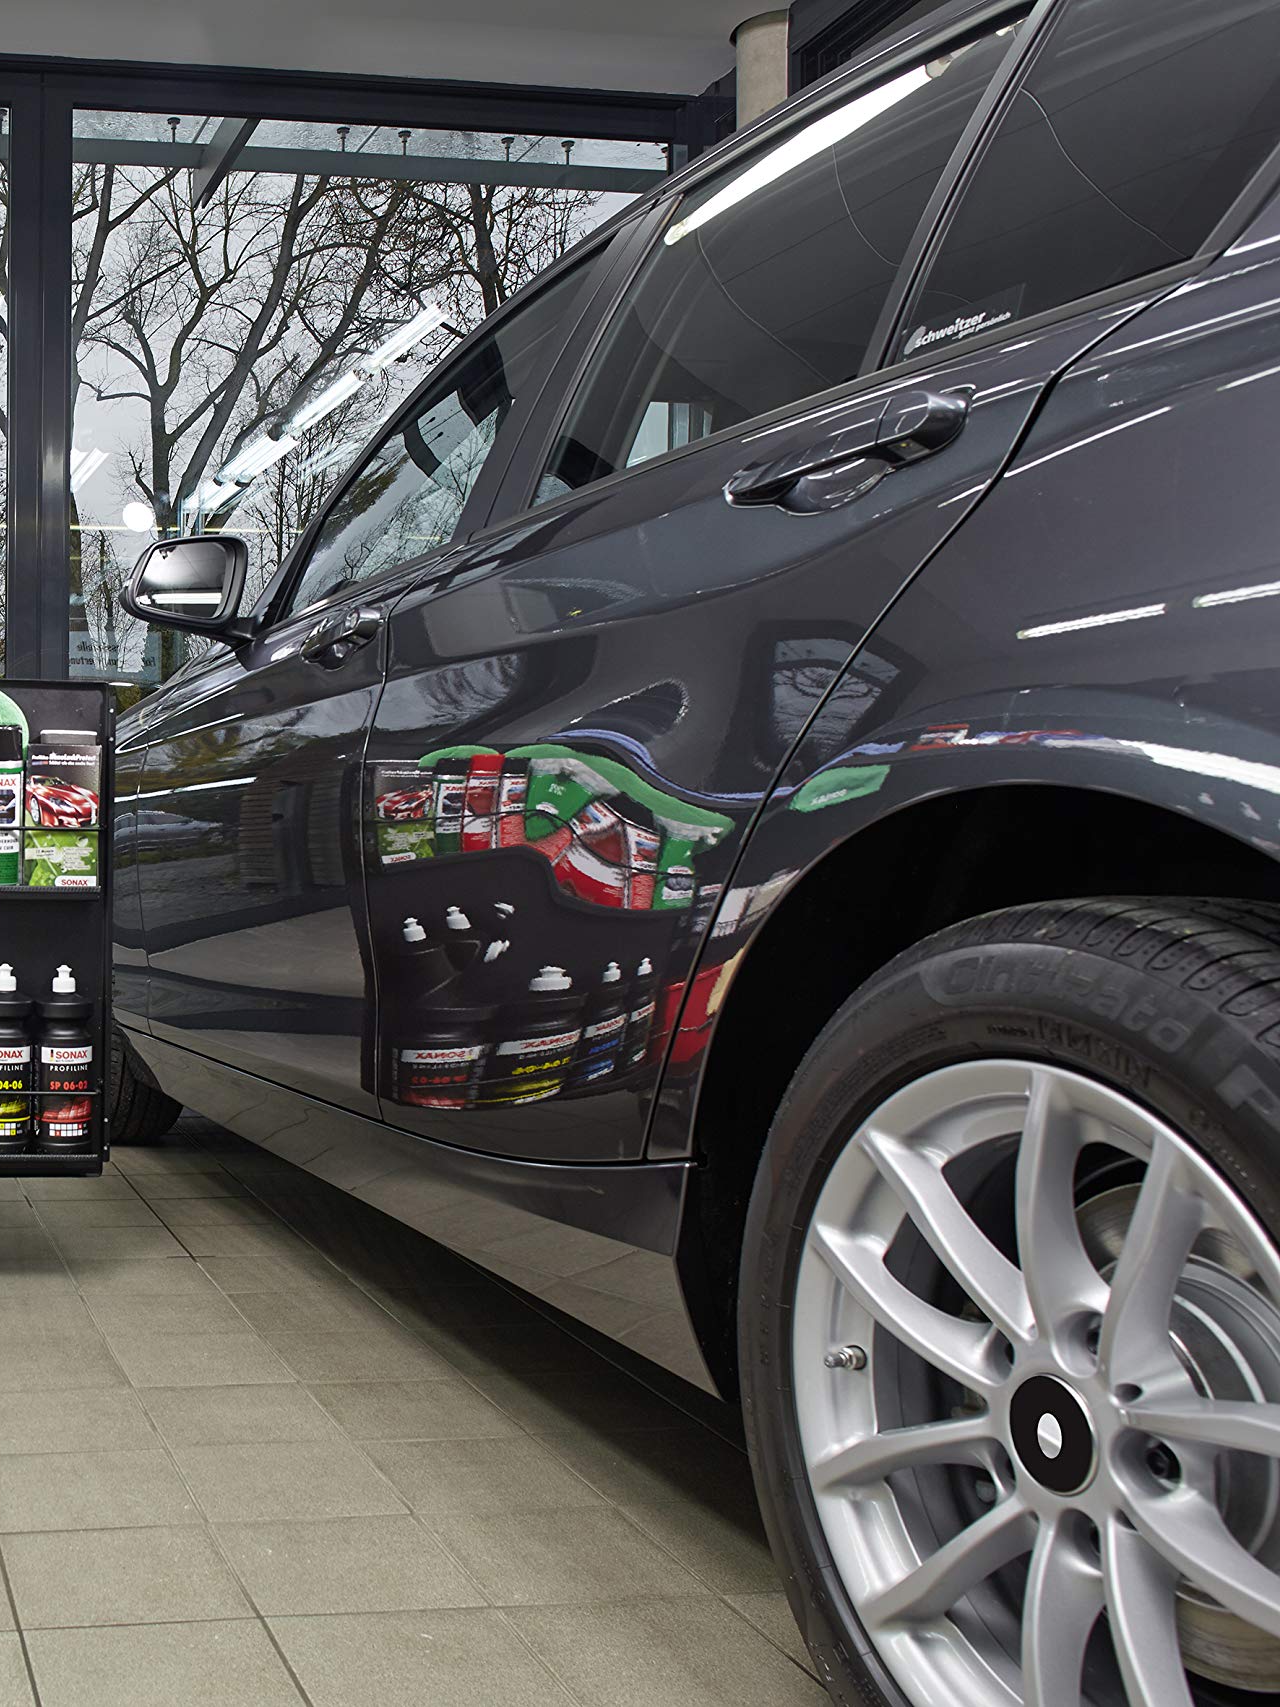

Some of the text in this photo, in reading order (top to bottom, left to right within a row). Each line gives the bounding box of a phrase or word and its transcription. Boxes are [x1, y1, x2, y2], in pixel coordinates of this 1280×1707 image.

[915, 311, 986, 348] schweitzer
[56, 1050, 88, 1059] SONAX
[50, 1064, 88, 1072] PROFILINE
[50, 1080, 88, 1090] SP 06-02
